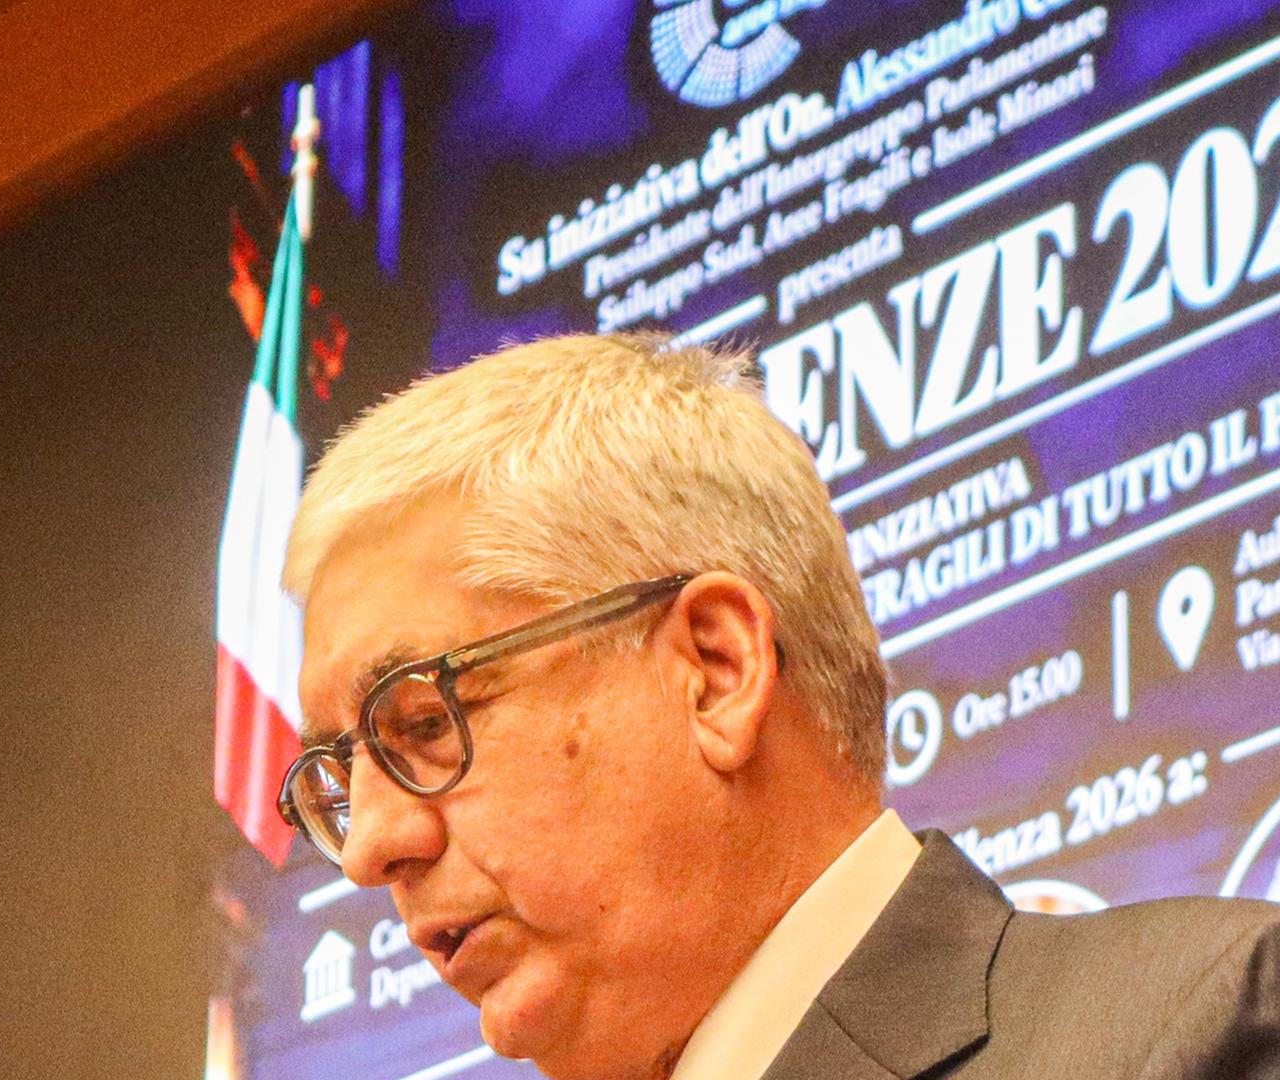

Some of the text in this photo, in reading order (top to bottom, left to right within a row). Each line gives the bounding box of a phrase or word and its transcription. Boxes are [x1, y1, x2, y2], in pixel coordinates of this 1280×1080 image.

[497, 235, 546, 295] Su
[546, 164, 701, 270] iniziativa
[701, 92, 836, 188] dell'On.
[835, 0, 1020, 120] Alessandro
[584, 209, 711, 298] Presidente
[712, 100, 924, 231] dell'Intergruppo
[925, 6, 1108, 121] Parlamentare
[598, 52, 1096, 334] Sviluppo Sud, Aree Fragili e Isole Minori
[759, 202, 1083, 482] ENZE
[777, 224, 903, 325] presenta
[1010, 494, 1060, 565] DI
[1063, 432, 1207, 538] TUTTO
[1209, 408, 1257, 476] IL
[952, 692, 1007, 739] Ore
[1065, 753, 1164, 845] 2026
[1167, 751, 1208, 804] a:
